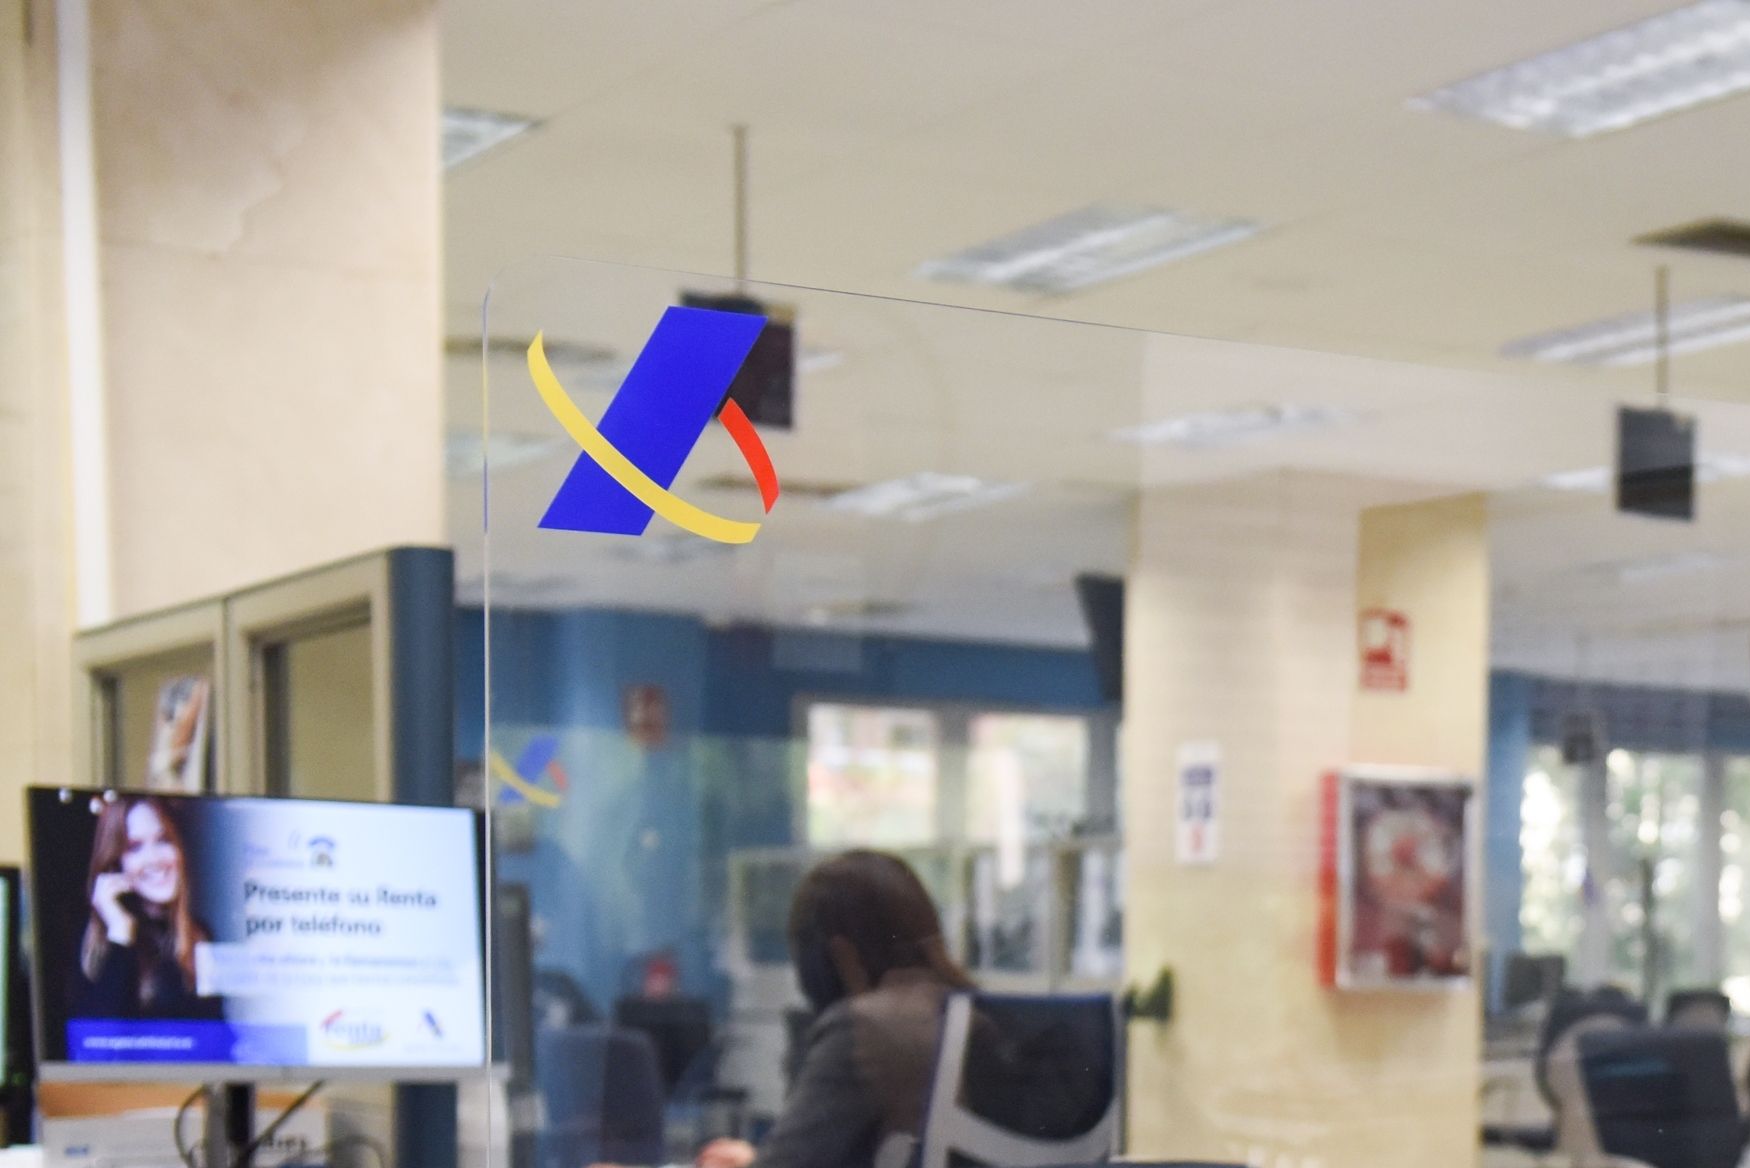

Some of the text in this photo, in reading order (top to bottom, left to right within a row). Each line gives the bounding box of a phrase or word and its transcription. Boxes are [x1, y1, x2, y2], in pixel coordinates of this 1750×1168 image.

[244, 880, 437, 907] Presente su Renta
[246, 916, 282, 937] por
